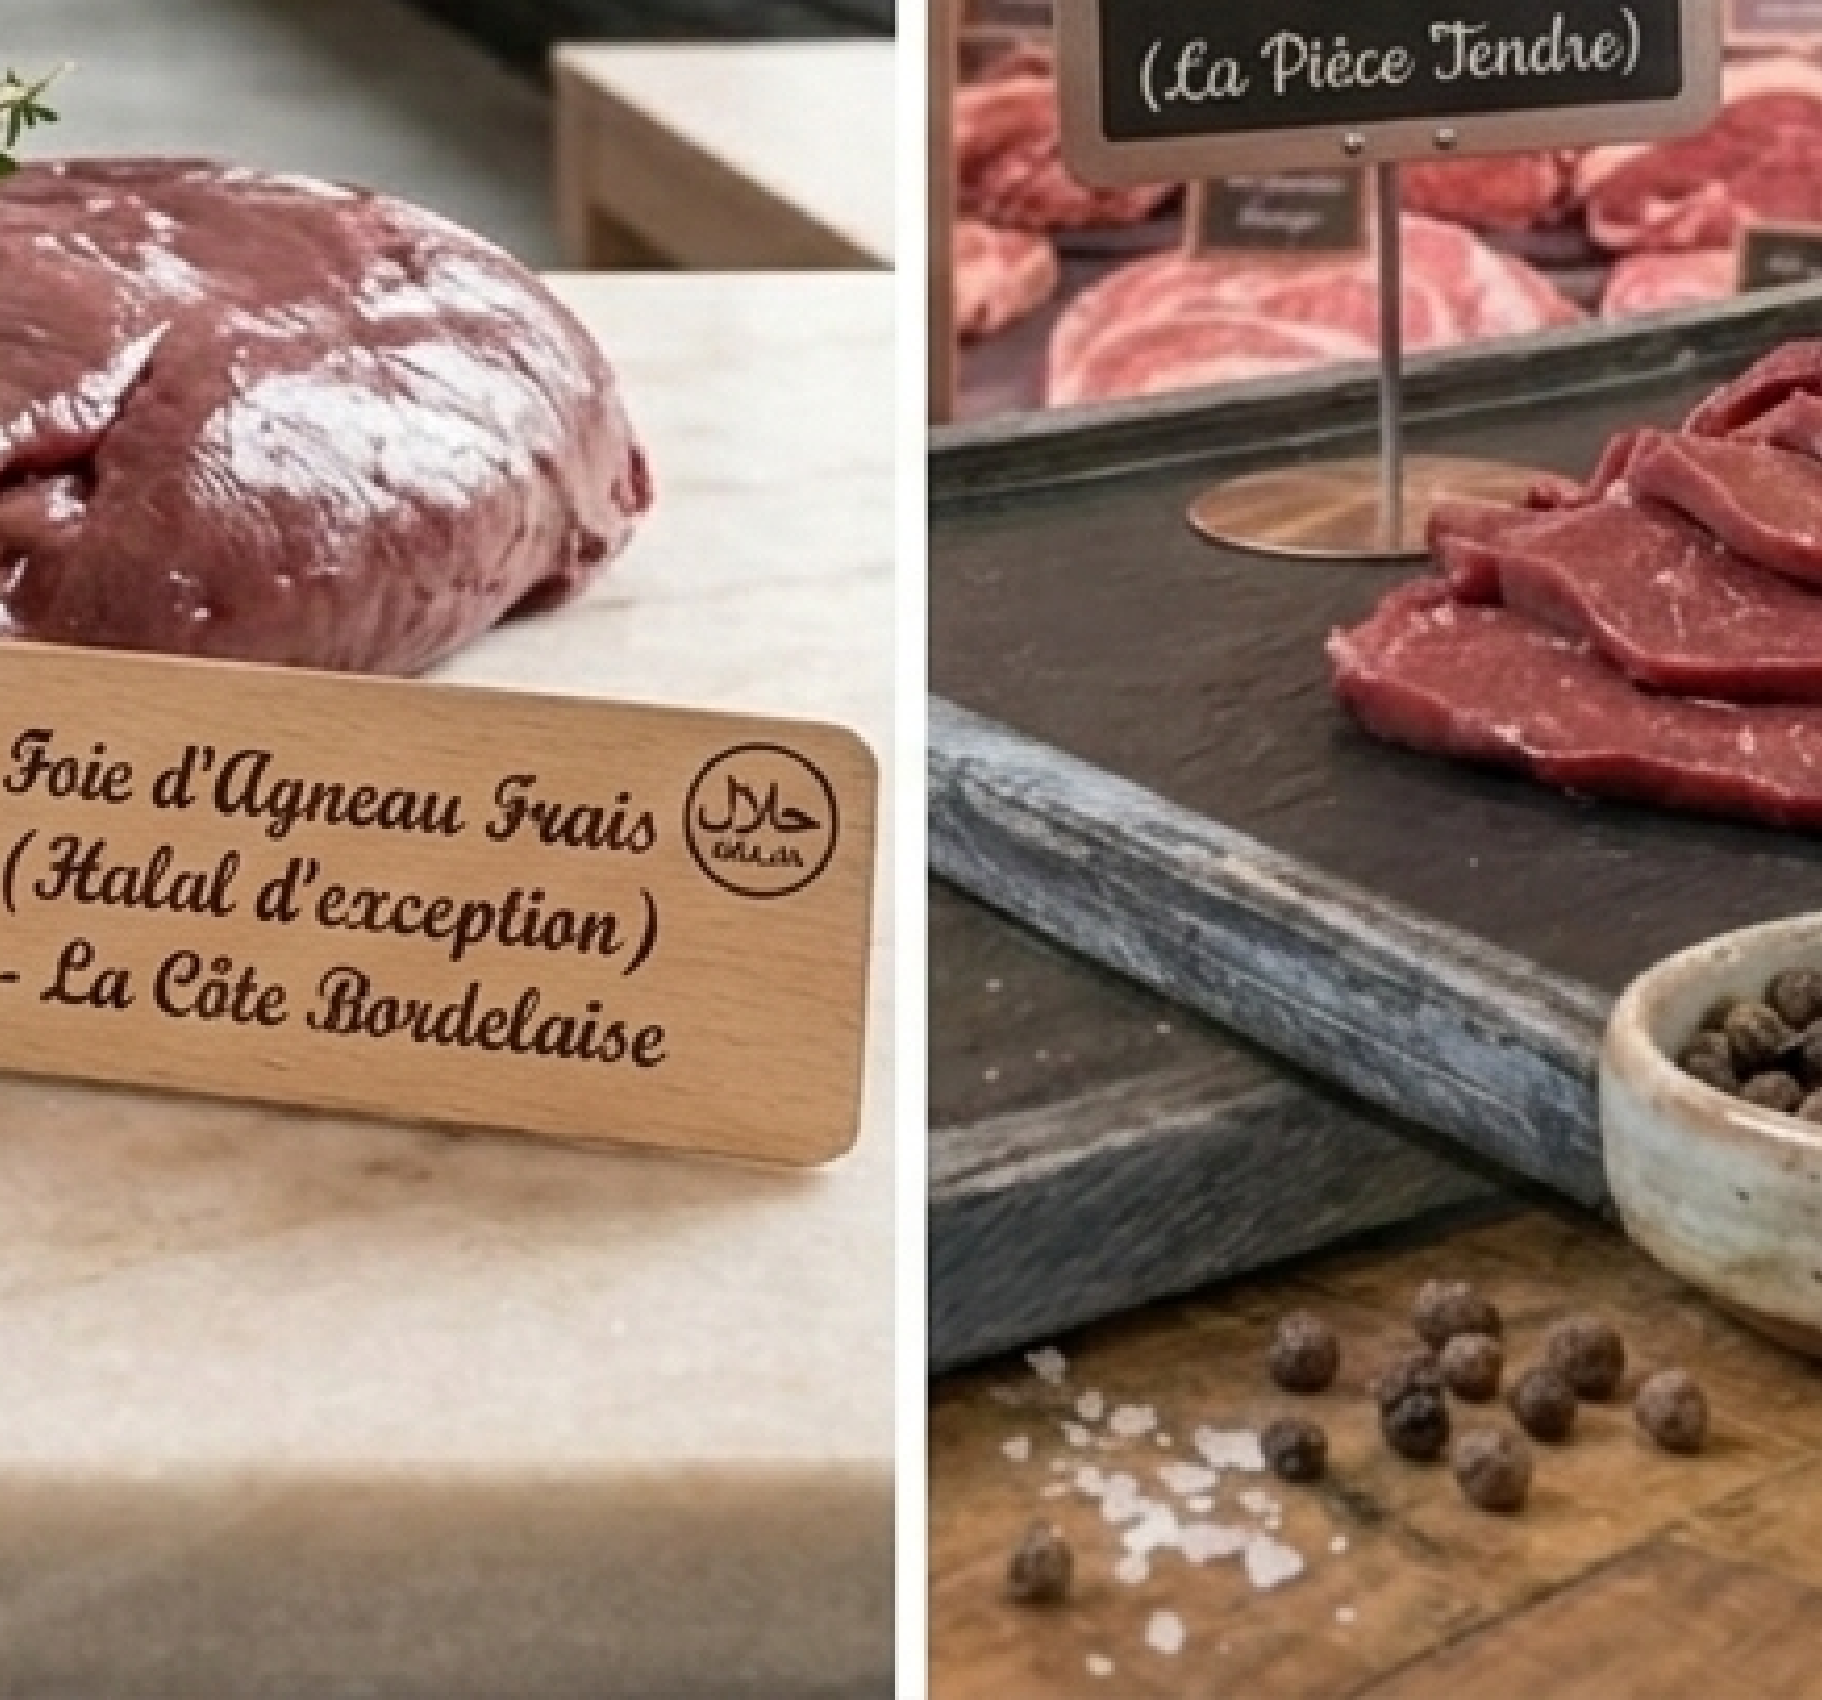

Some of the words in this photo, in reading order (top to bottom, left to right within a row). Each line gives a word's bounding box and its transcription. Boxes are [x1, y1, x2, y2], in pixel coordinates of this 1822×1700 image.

[1428, 7, 1642, 82] Tendre)
[1, 728, 133, 805] Foie
[152, 744, 464, 840] d'Agneau
[485, 774, 657, 855] Frais
[1, 829, 237, 918] (Halal
[255, 859, 660, 976] d'exception)
[39, 939, 134, 1011] La
[152, 948, 288, 1028] Côte
[307, 965, 667, 1069] Bordelaise
